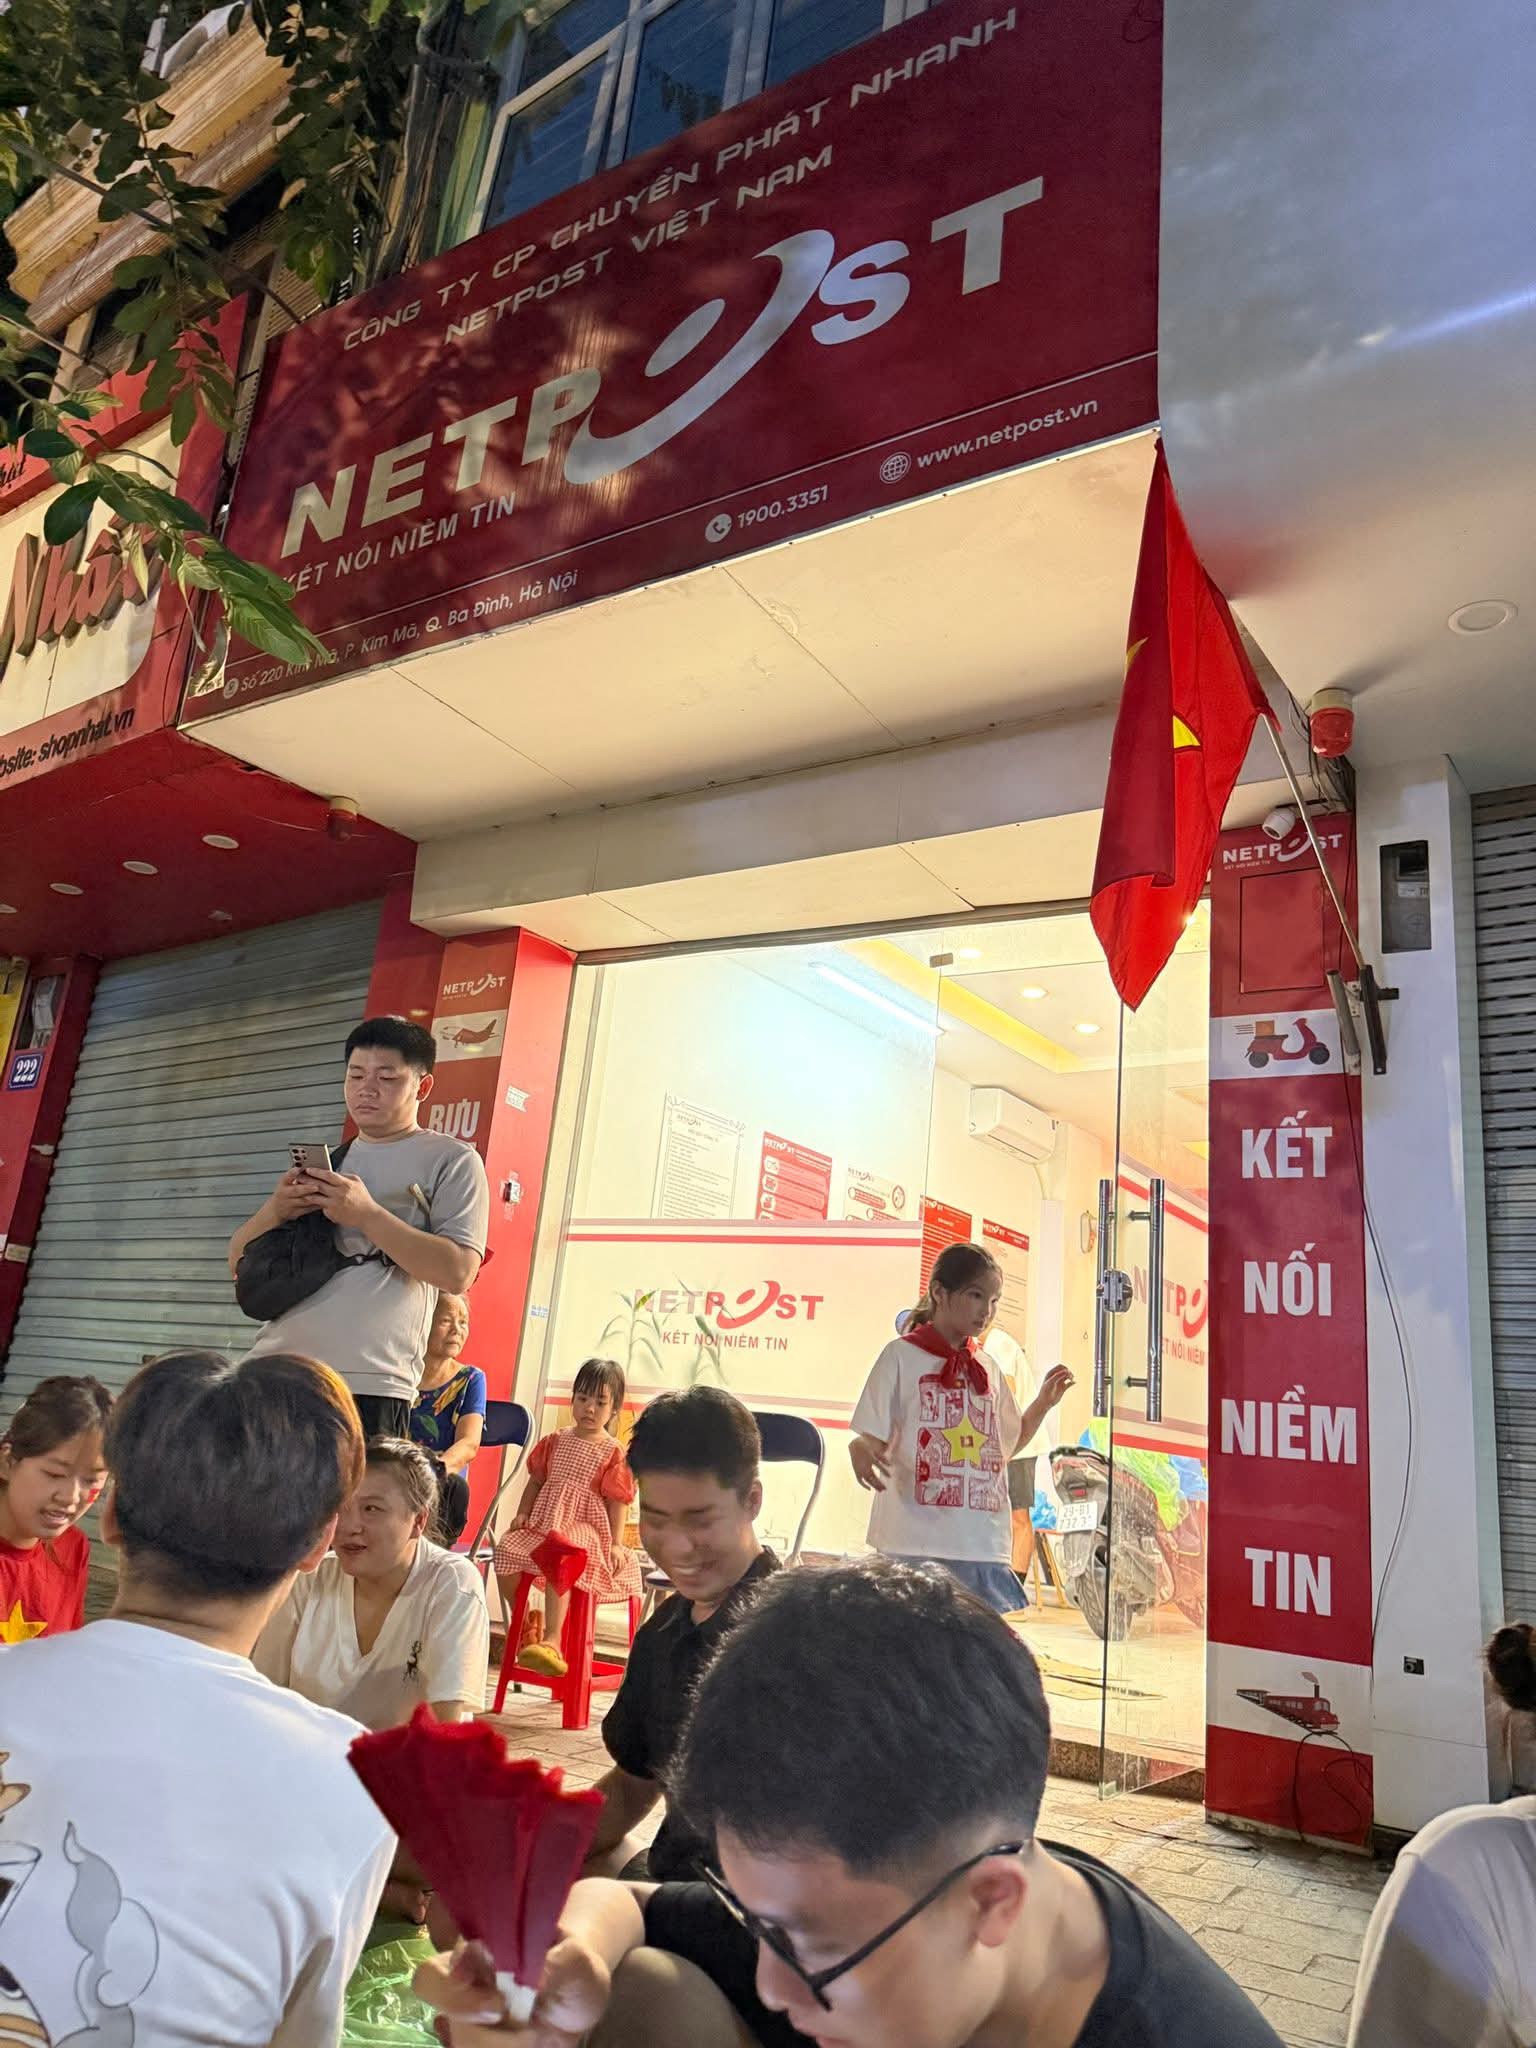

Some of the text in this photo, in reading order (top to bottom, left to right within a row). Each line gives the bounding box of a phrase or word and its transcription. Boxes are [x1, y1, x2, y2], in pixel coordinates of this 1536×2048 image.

[344, 8, 1016, 350] CÔNG TY CP CHUYỂN PHÁT NHANH
[444, 145, 833, 345] NETPOST VIỆT NAM
[280, 176, 1044, 559] NETPOST
[916, 399, 1099, 469] www.netpost.vn
[470, 491, 516, 529] TIN
[737, 485, 829, 529] 1900.3351
[259, 664, 283, 686] 220
[361, 634, 389, 653] Kim
[392, 621, 421, 643] Mã,
[425, 615, 443, 633] Q.
[447, 609, 469, 626] Ba
[473, 593, 514, 618] Đình,
[519, 580, 544, 603] Hà
[547, 569, 579, 594] Nội
[443, 973, 506, 996] NETPOST
[13, 1058, 38, 1083] 222
[428, 1098, 481, 1139] BƯU
[1241, 1110, 1333, 1180] KẾT
[634, 1280, 824, 1330] NETPOST
[1243, 1242, 1332, 1317] NỐI
[766, 1336, 788, 1351] TIN
[1221, 1384, 1357, 1465] NIỀM
[1244, 1546, 1331, 1617] TIN
